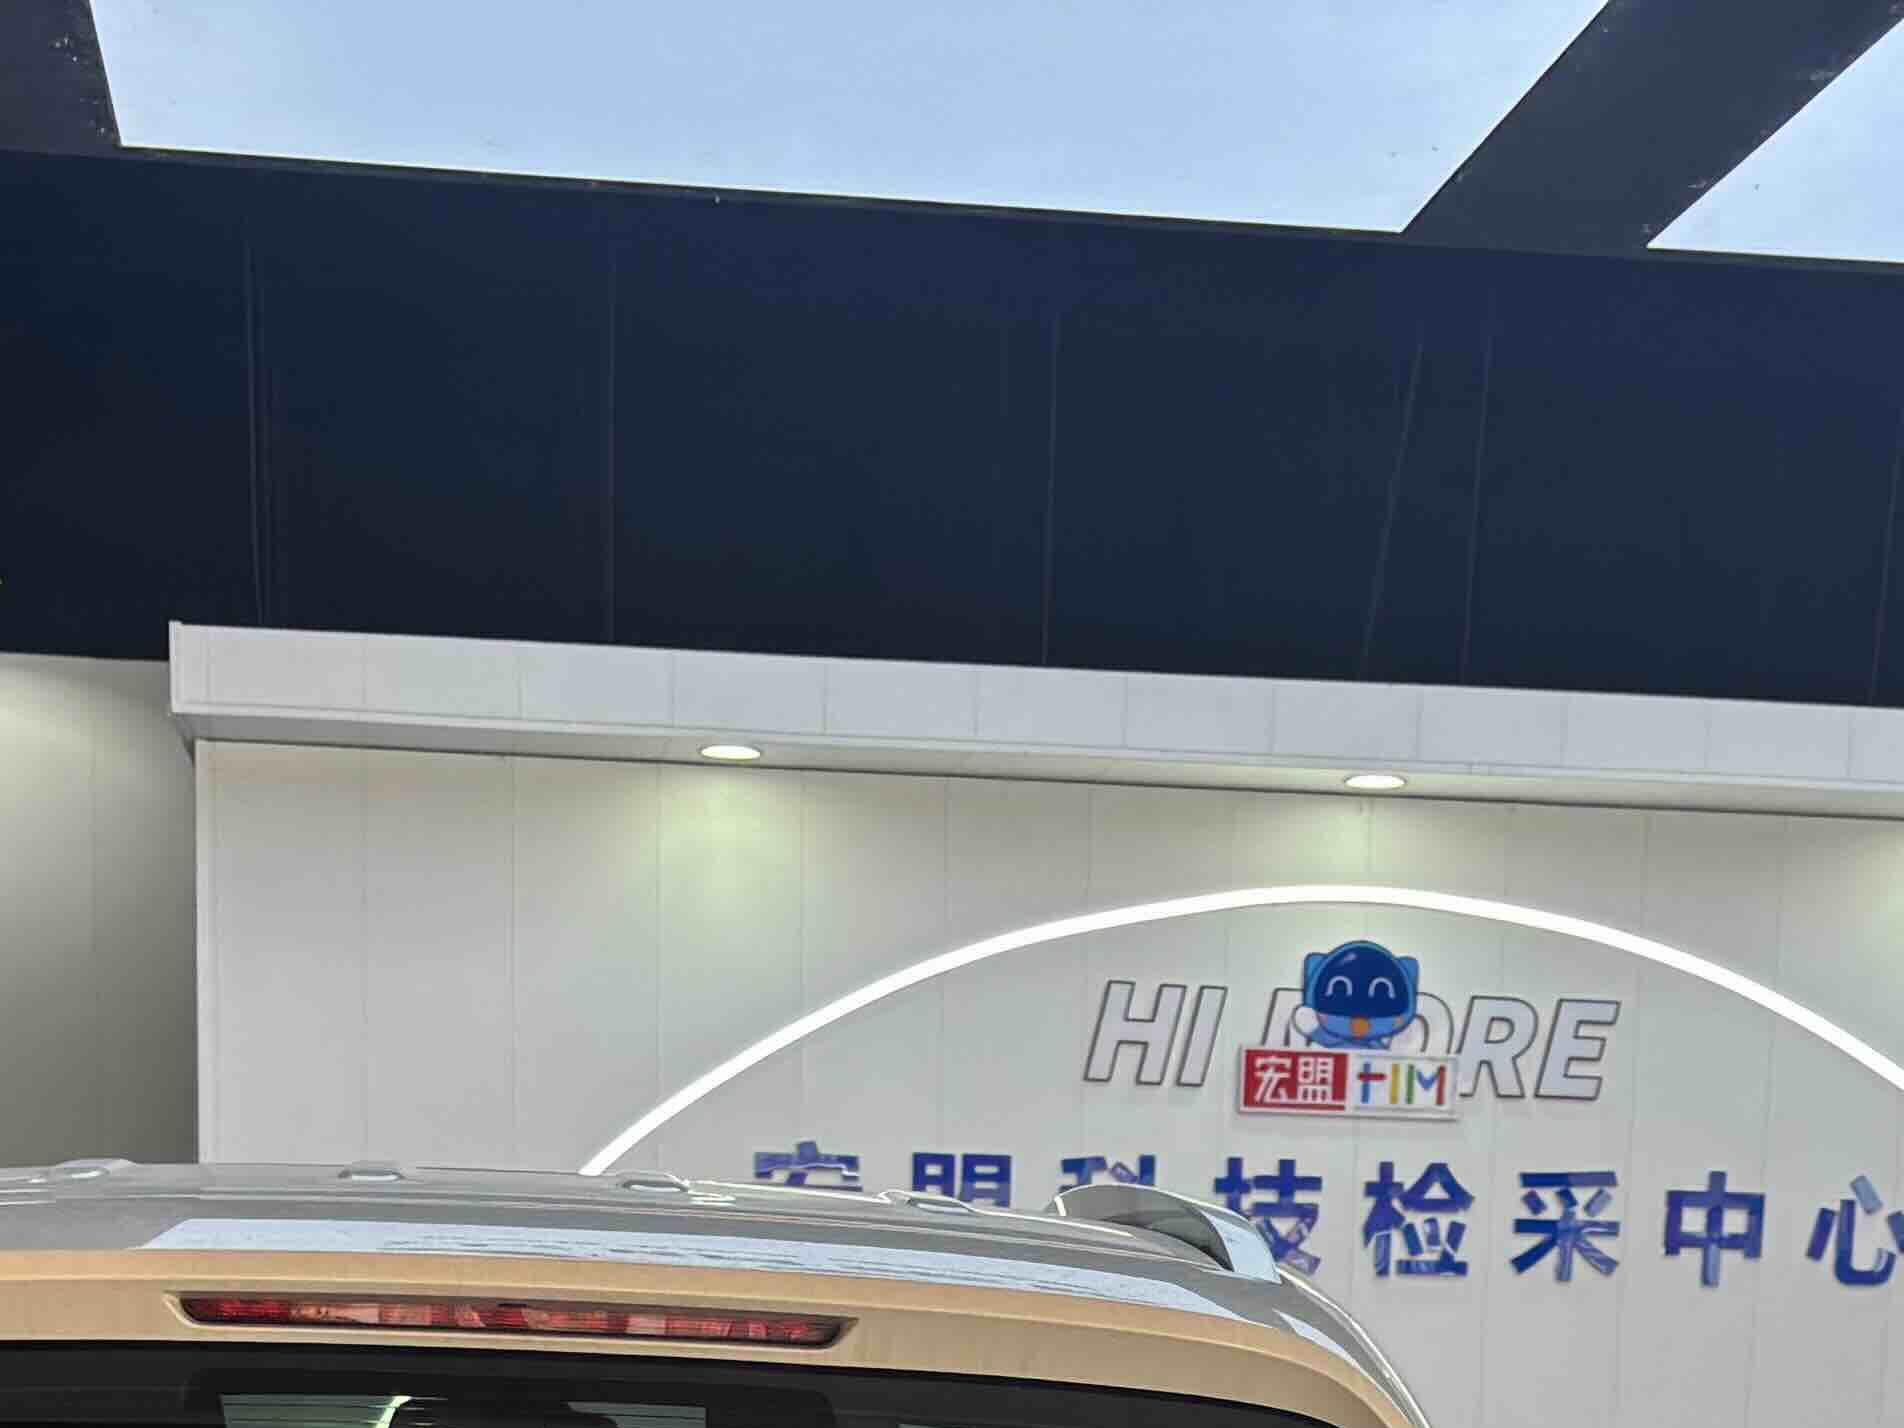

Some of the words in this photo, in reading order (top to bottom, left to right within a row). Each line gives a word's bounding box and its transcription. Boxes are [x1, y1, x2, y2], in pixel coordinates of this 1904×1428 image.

[1083, 980, 1228, 1087] HI
[1261, 987, 1622, 1100] RE
[1253, 1055, 1336, 1104] 宏盟
